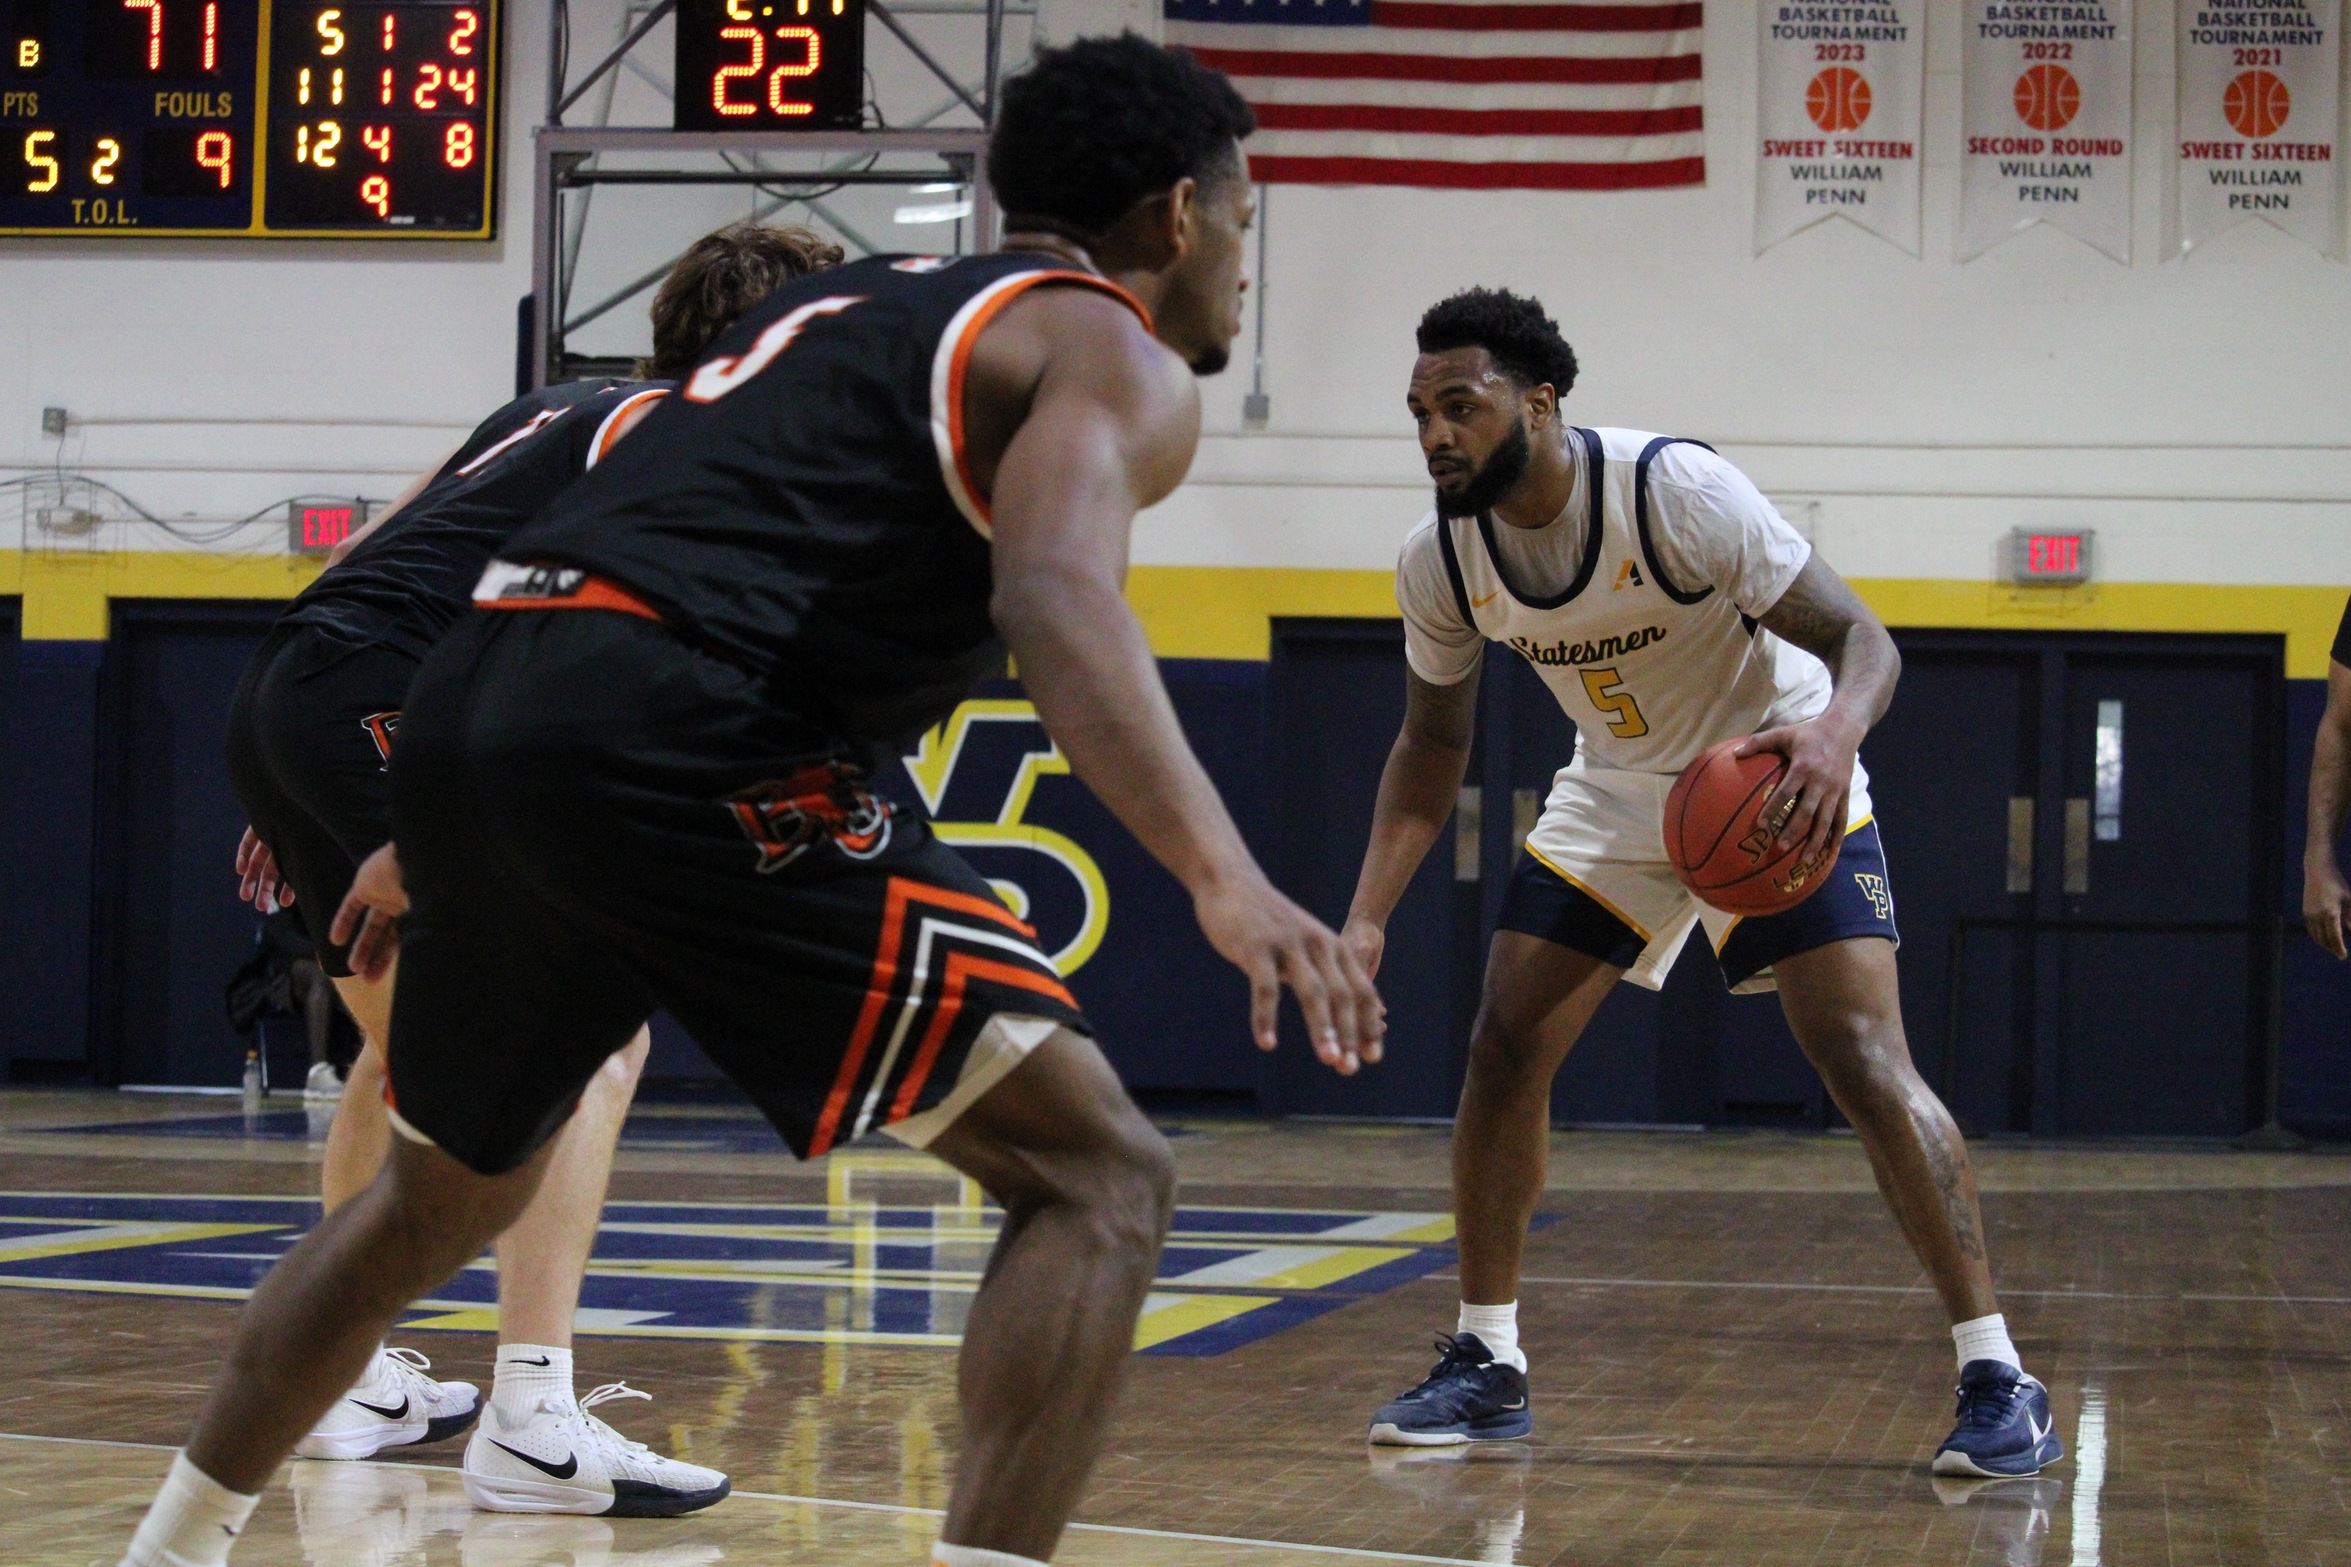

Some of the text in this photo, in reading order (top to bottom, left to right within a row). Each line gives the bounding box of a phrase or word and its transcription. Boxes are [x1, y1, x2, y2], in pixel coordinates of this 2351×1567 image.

[1779, 8, 1899, 23] BASKETBALL
[1986, 6, 2107, 22] BASKETBALL
[2197, 12, 2315, 27] BASKETBALL
[123, 0, 217, 70] 71
[317, 9, 477, 56] 5 1 2
[1772, 24, 1907, 41] TOURNAMENT
[1978, 24, 2116, 39] TOURNAMENT
[2190, 29, 2324, 45] TOURNAMENT
[1815, 44, 1866, 61] 2023
[2022, 42, 2073, 60] 2022
[2233, 48, 2282, 66] 2021
[713, 26, 820, 116] 22
[299, 63, 476, 110] 11 1 24
[3, 92, 39, 117] PTS
[155, 92, 232, 117] FOULS
[296, 121, 474, 169] 12 4 8
[1764, 140, 1913, 160] SWEET SIXTEEN
[1968, 137, 2124, 157] SECOND ROUND
[2181, 142, 2331, 162] SWEET SIXTEEN
[92, 138, 119, 185] 2
[196, 131, 232, 189] 9
[1999, 161, 2093, 178] WILLIAM
[1790, 165, 1883, 181] WILLIAM
[2209, 169, 2302, 186] WILLIAM
[361, 175, 389, 218] 9
[1806, 188, 1866, 205] PENN
[2019, 185, 2078, 203] PENN
[2229, 193, 2289, 210] PENN
[71, 199, 138, 225] T.O.L.
[303, 508, 353, 546] EXIT
[2029, 535, 2081, 572] EXIT
[1509, 625, 1667, 666] Statesmen
[1579, 667, 1649, 738] 5
